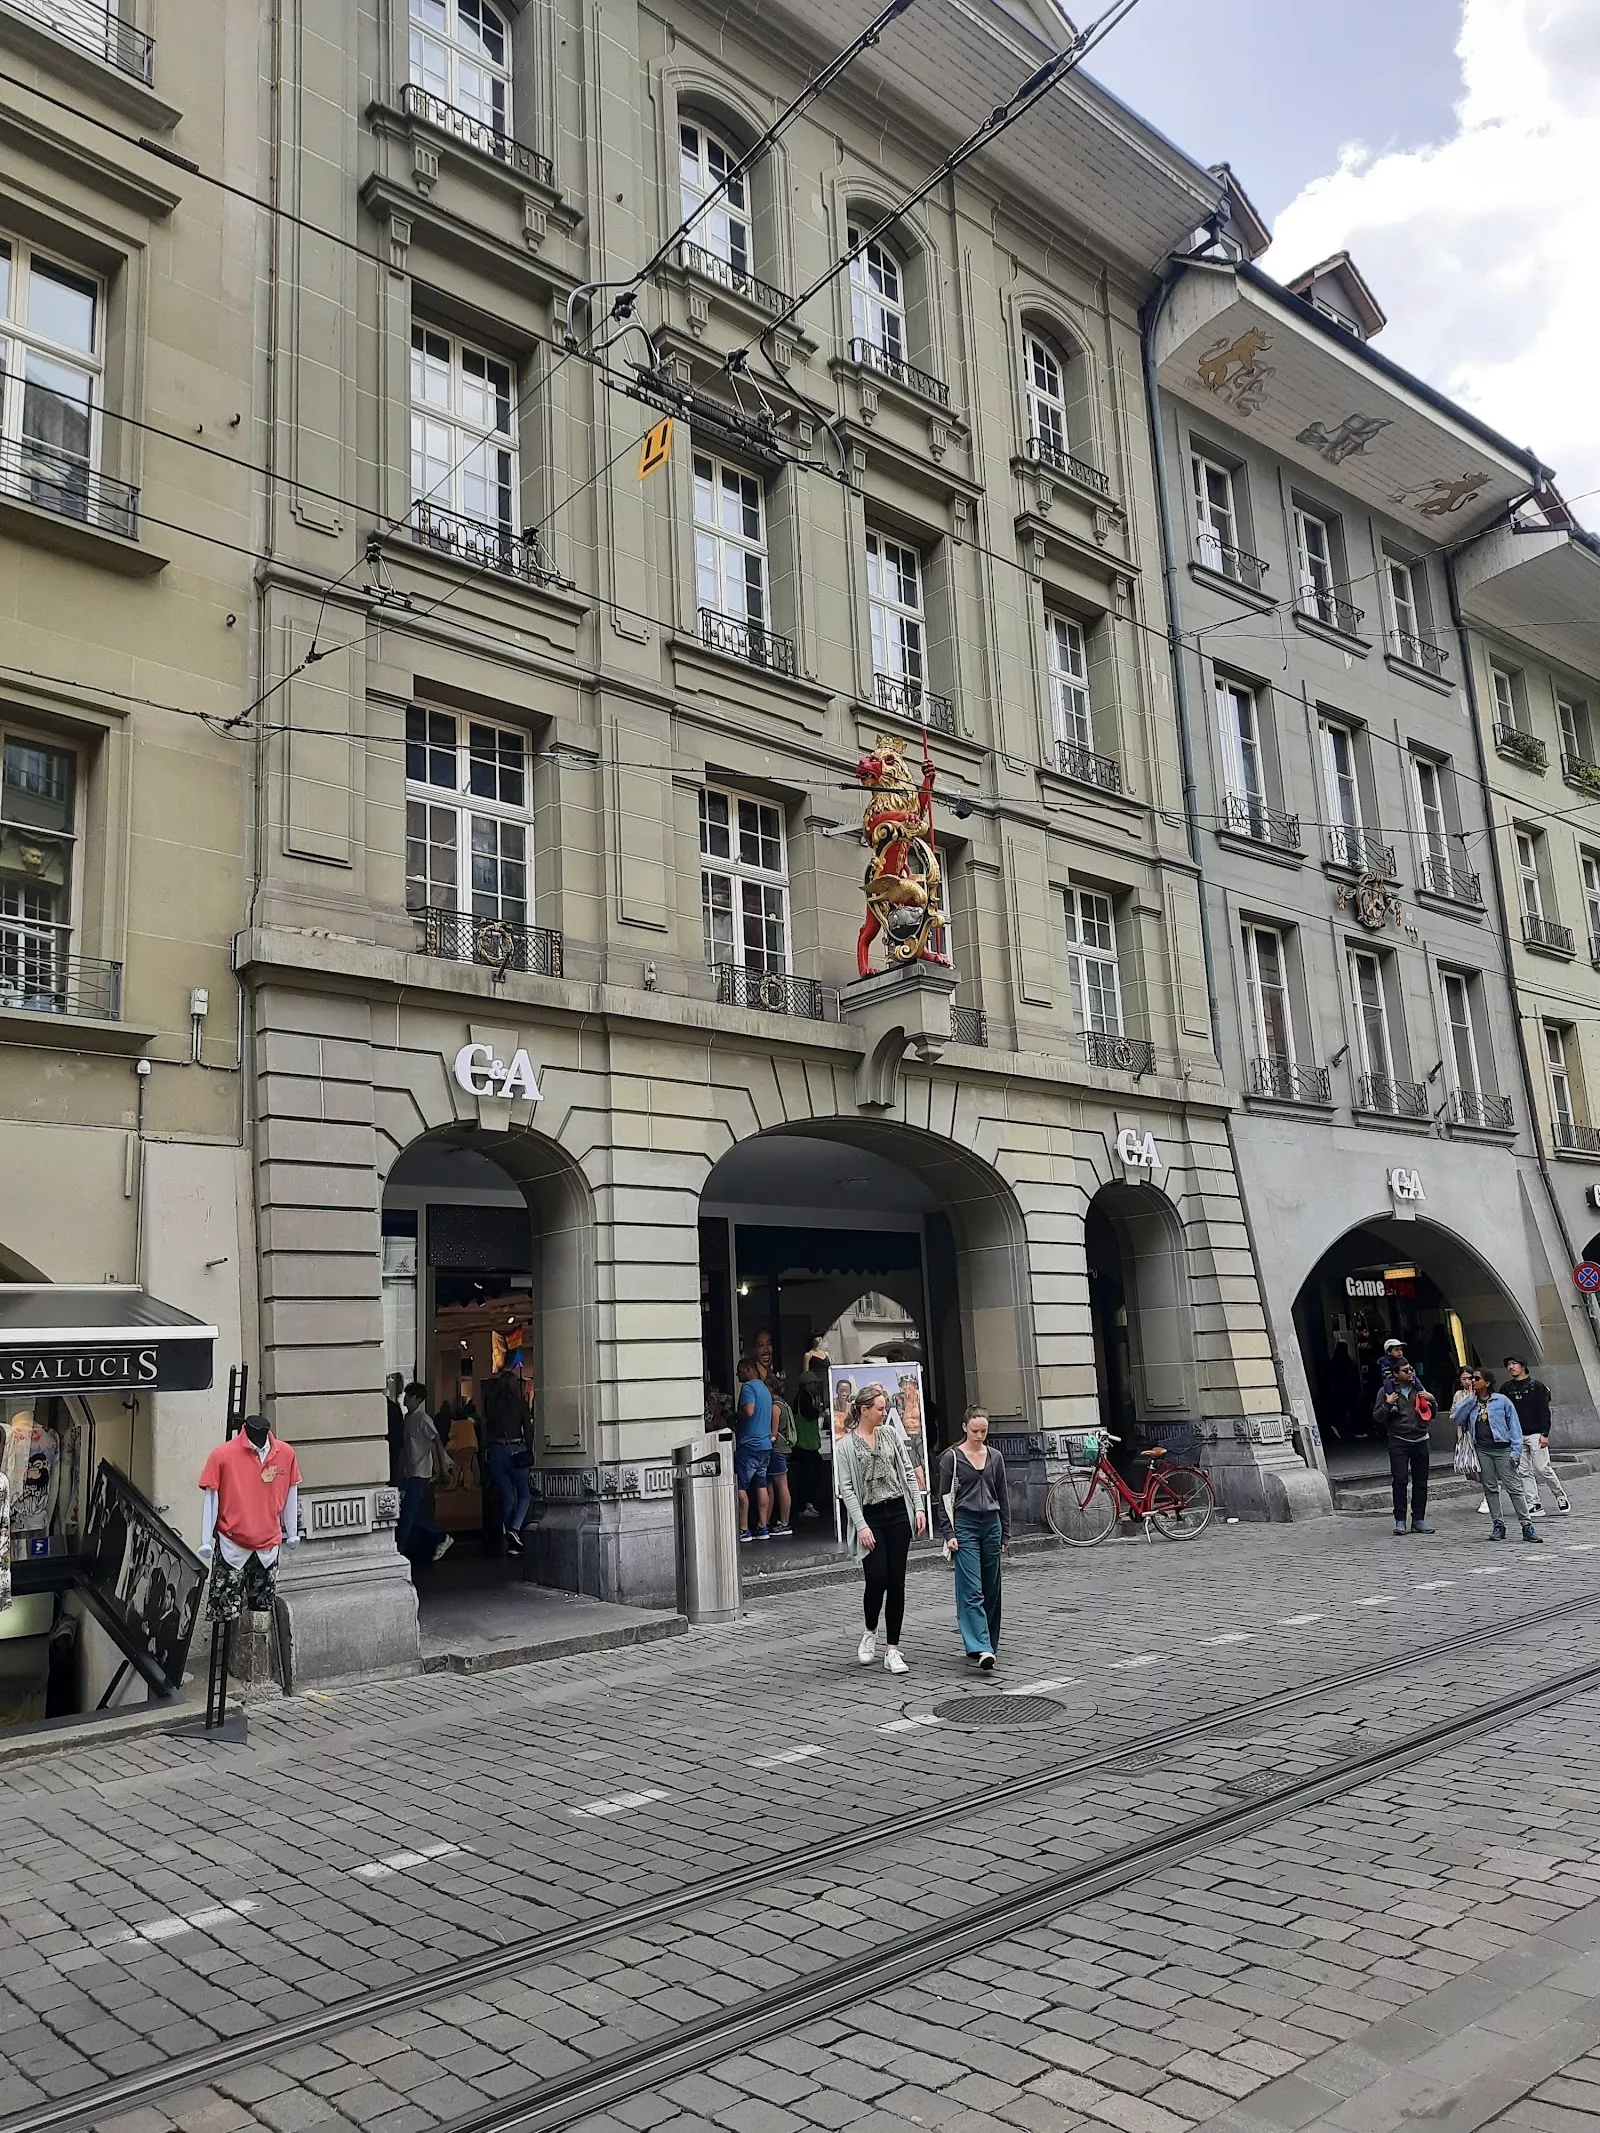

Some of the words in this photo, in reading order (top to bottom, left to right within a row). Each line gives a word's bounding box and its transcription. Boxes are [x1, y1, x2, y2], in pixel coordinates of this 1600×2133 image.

[454, 1042, 544, 1101] C&A
[1117, 1128, 1163, 1168] C&A
[1391, 1168, 1427, 1200] C&A
[0, 1350, 158, 1381] SALUCIS
